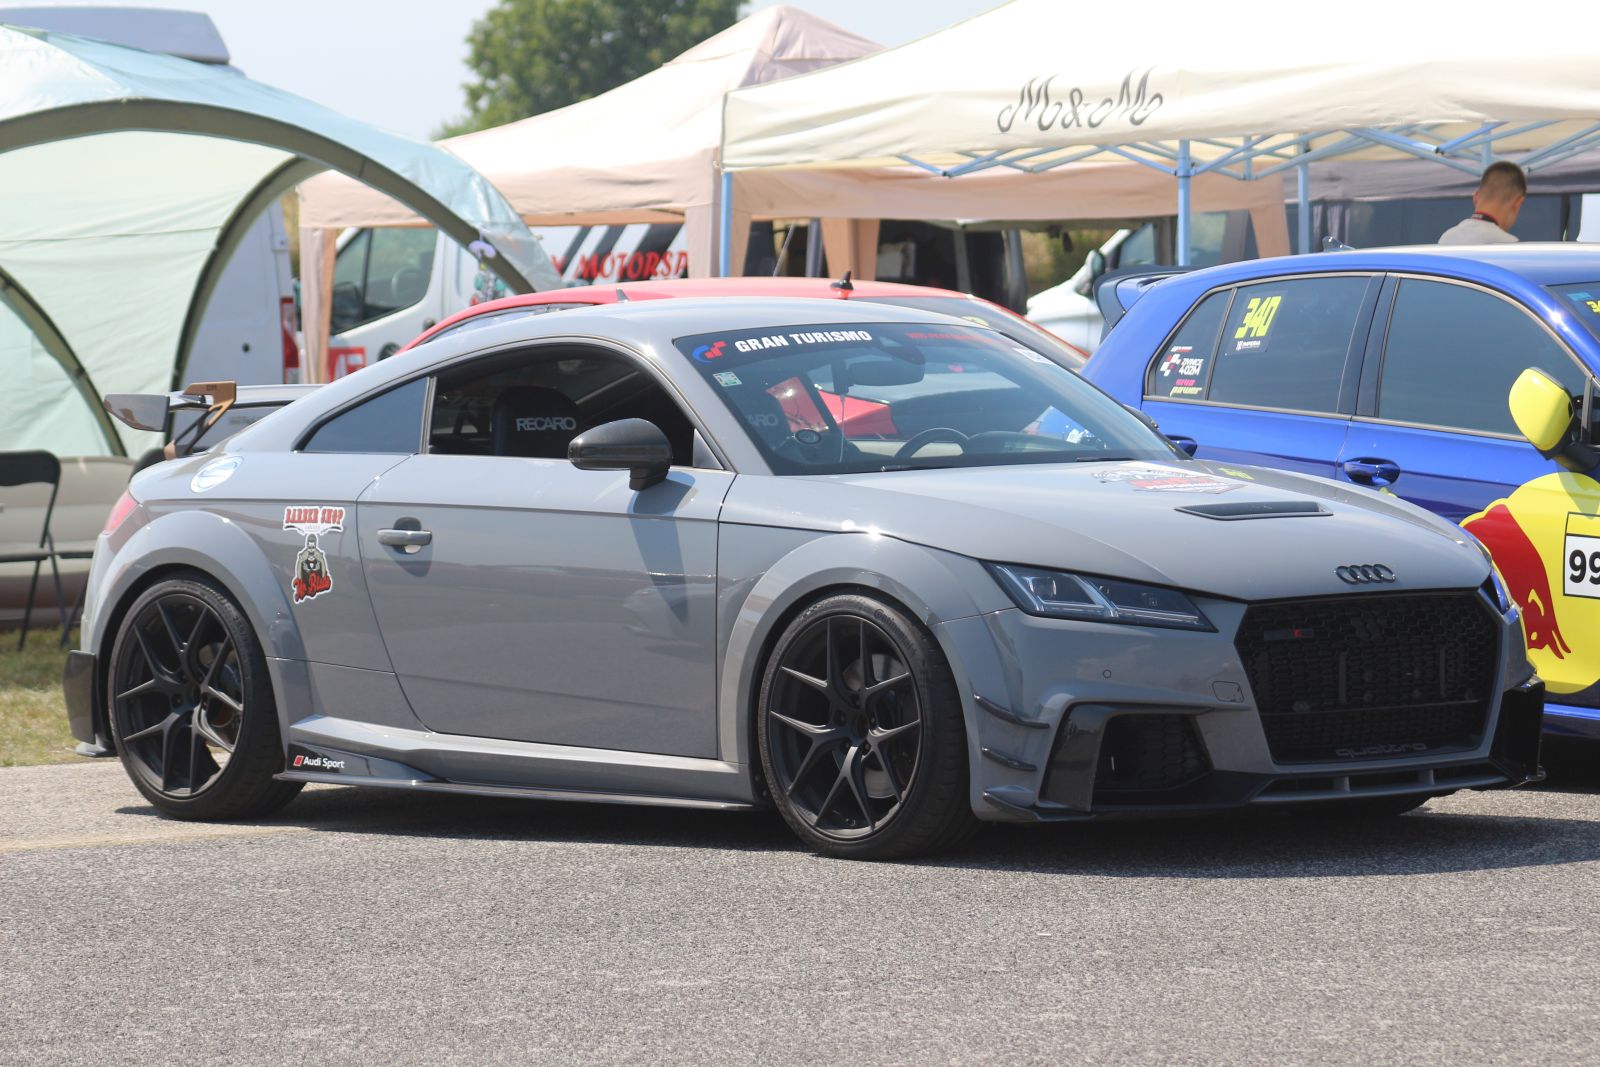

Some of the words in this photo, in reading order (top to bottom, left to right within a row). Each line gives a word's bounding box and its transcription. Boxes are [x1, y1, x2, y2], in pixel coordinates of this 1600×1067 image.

[1234, 296, 1281, 339] 340
[734, 335, 789, 352] GRAN
[789, 330, 872, 345] TURISMO
[516, 416, 577, 432] RECARO
[284, 508, 320, 524] BARBER
[320, 508, 344, 525] SHOP
[303, 756, 322, 766] Audi
[322, 758, 345, 769] Sport
